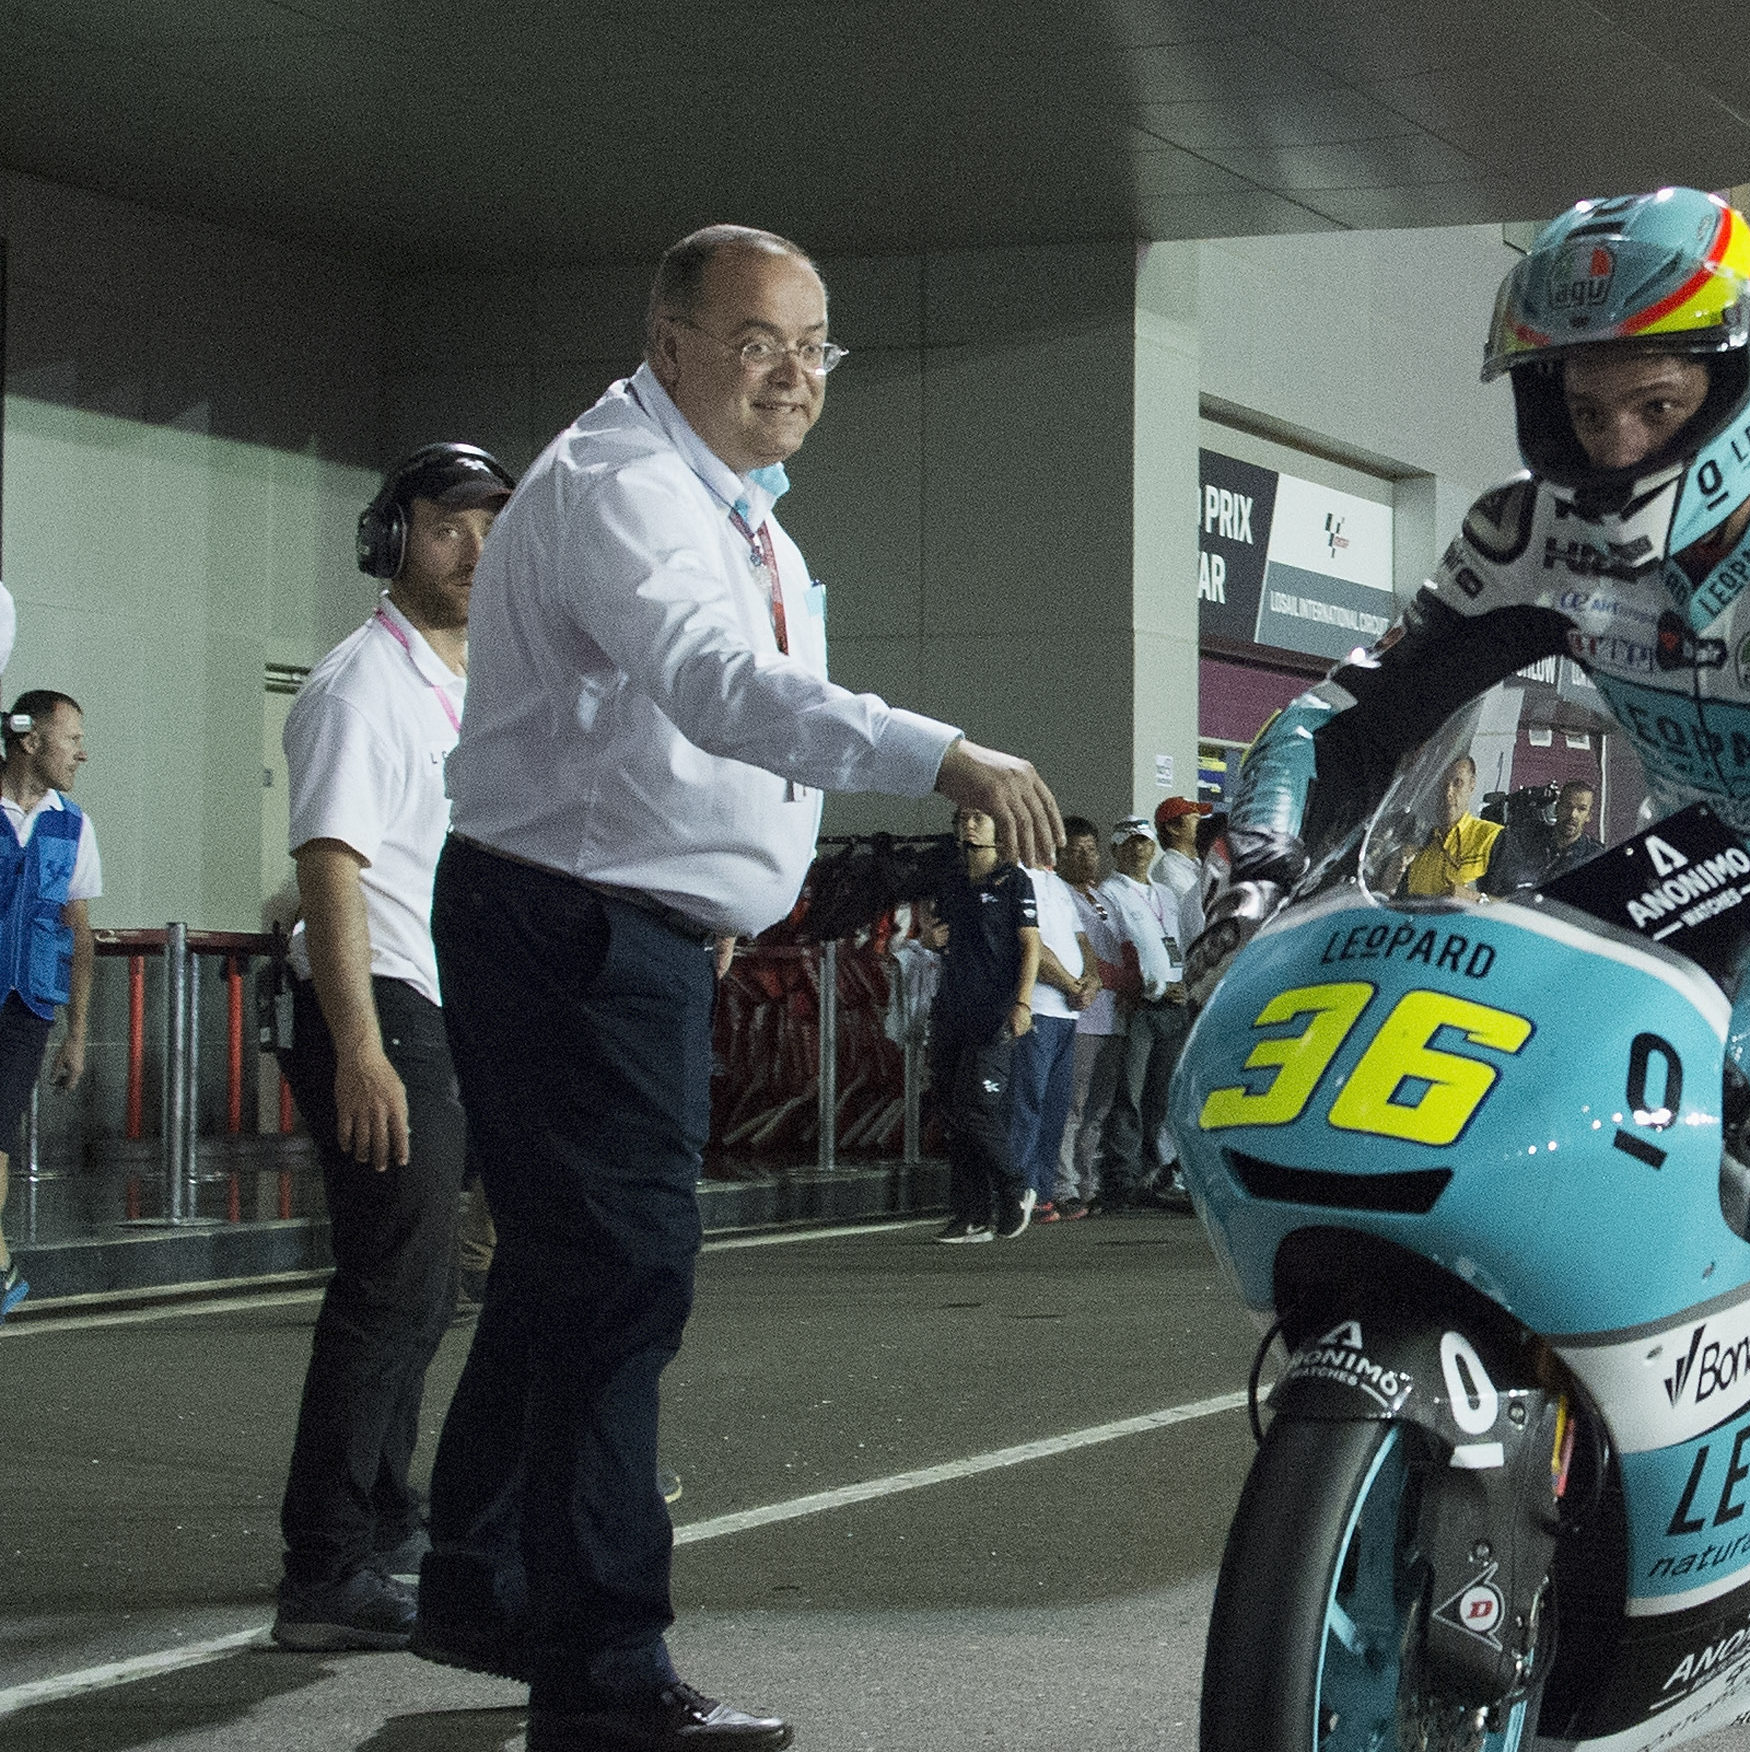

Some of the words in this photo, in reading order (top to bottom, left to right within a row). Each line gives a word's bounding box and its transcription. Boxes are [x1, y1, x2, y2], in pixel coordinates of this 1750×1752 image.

[1204, 483, 1254, 545] PRIX
[1198, 551, 1226, 605] AR
[1319, 921, 1498, 980] LEOPARD
[1199, 980, 1537, 1148] 36
